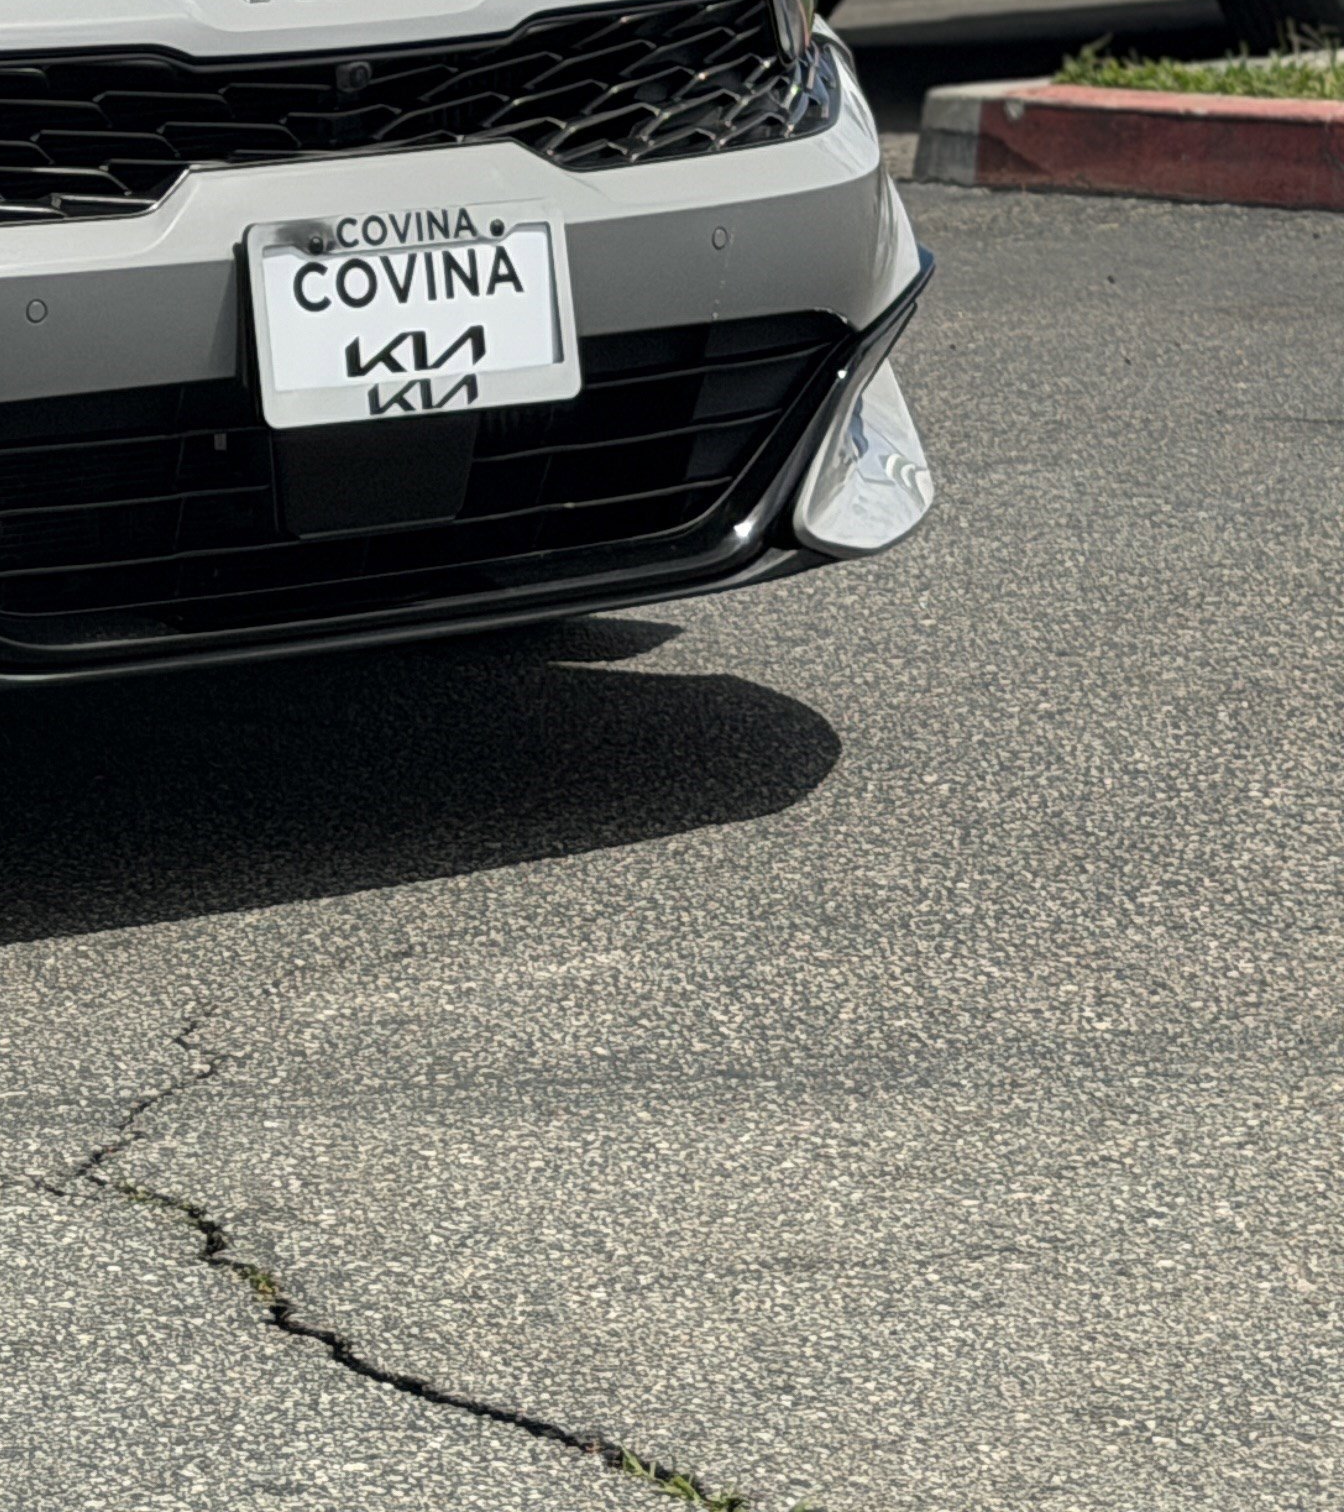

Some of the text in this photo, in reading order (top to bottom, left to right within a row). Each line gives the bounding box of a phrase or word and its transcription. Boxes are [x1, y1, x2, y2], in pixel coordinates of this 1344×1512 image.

[335, 207, 478, 248] COVINA
[292, 245, 525, 312] COVINA
[345, 325, 487, 378] KIA
[367, 373, 479, 416] KIA
